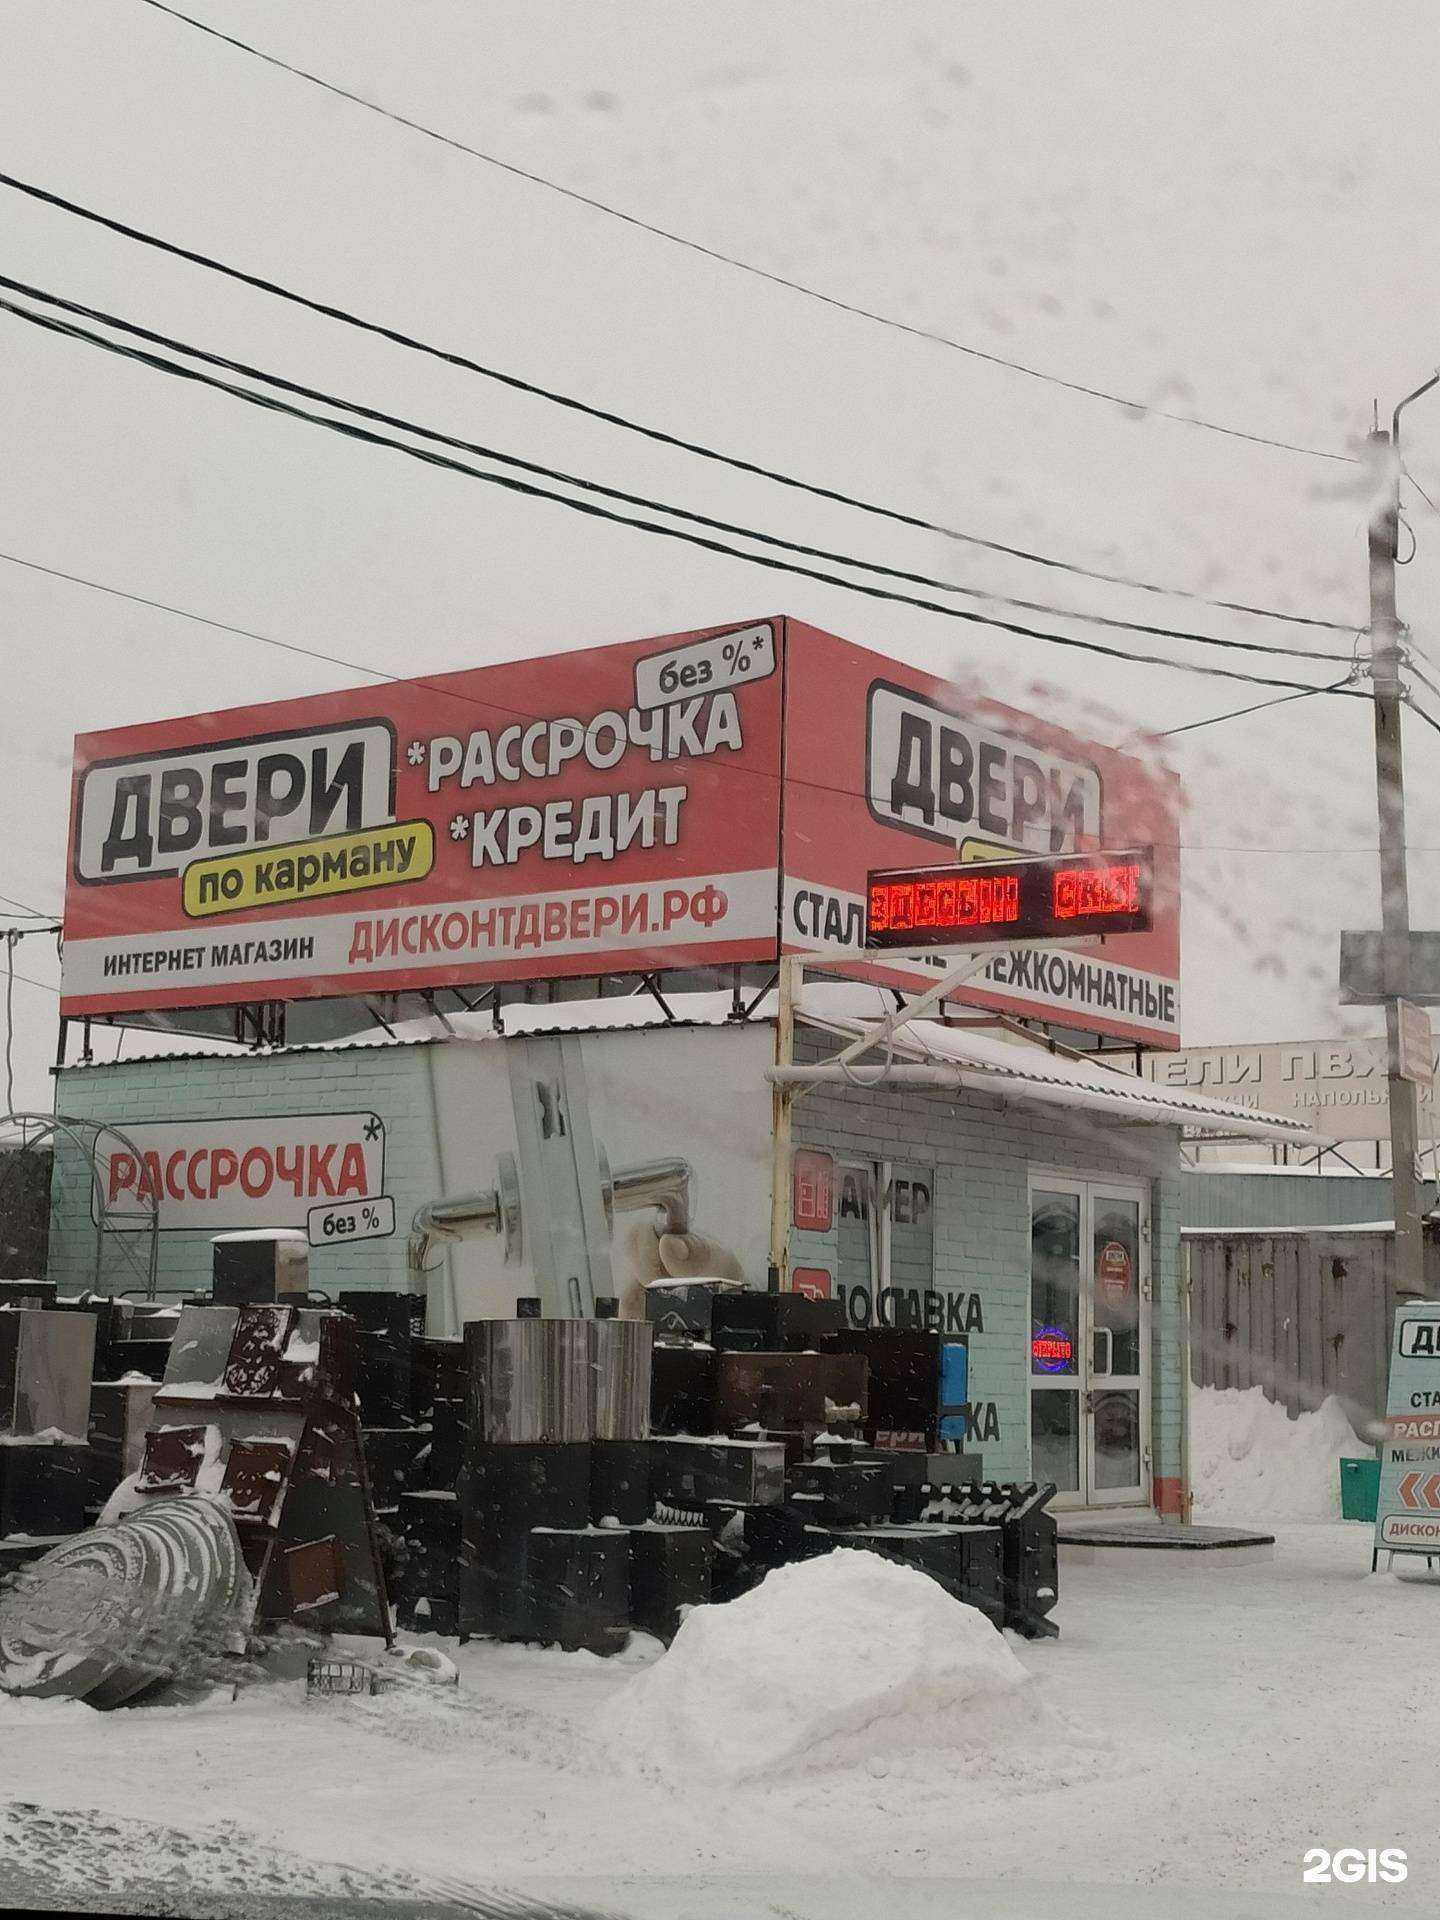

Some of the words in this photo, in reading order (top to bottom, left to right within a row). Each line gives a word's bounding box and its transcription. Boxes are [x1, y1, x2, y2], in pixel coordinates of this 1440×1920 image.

[659, 659, 713, 694] без
[101, 742, 365, 872] ДВЕРИ
[891, 711, 1085, 853] ДВЕРИ
[199, 868, 243, 904] по
[255, 836, 416, 893] карману
[348, 884, 729, 964] ДИСКОНТДВЕРИ.РФ
[104, 946, 206, 977] ИНТЕРНЕТ
[211, 936, 315, 967] МАГАЗИН
[322, 1213, 356, 1237] без
[362, 1207, 380, 1230] %
[1411, 1325, 1440, 1355] Д
